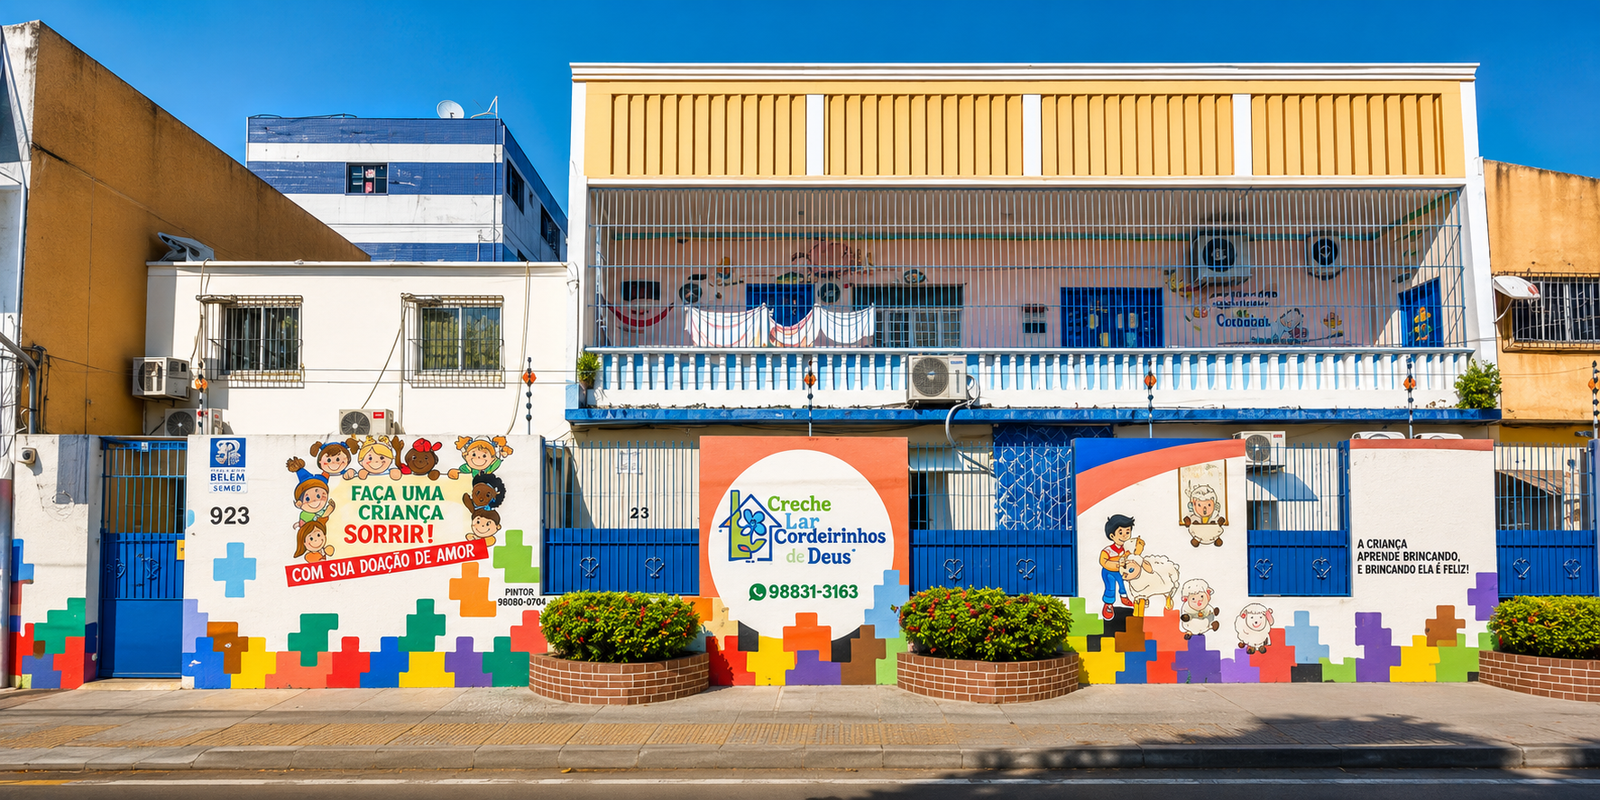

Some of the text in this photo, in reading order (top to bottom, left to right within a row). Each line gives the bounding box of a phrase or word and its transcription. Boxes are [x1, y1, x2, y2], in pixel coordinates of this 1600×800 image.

[210, 473, 245, 482] BELEM
[351, 485, 444, 504] FAÇA UMA
[767, 495, 831, 512] Creche
[210, 506, 250, 525] 923
[358, 504, 444, 523] CRIANÇA
[630, 507, 649, 519] 23
[785, 513, 820, 529] Lar
[343, 524, 434, 544] SORRIR!
[774, 527, 886, 544] Cordeirinhos
[1357, 539, 1408, 550] A CRIANÇA
[786, 548, 804, 563] de
[1357, 552, 1400, 561] APRENDE
[292, 544, 475, 583] COM SUA DOAÇÃO DE AMOR
[1358, 562, 1470, 574] E BRINCANDO ELA É FELIZ!
[505, 588, 534, 596] PINTOR
[769, 584, 858, 598] 98831-3163
[498, 598, 546, 606] 98080-0704
